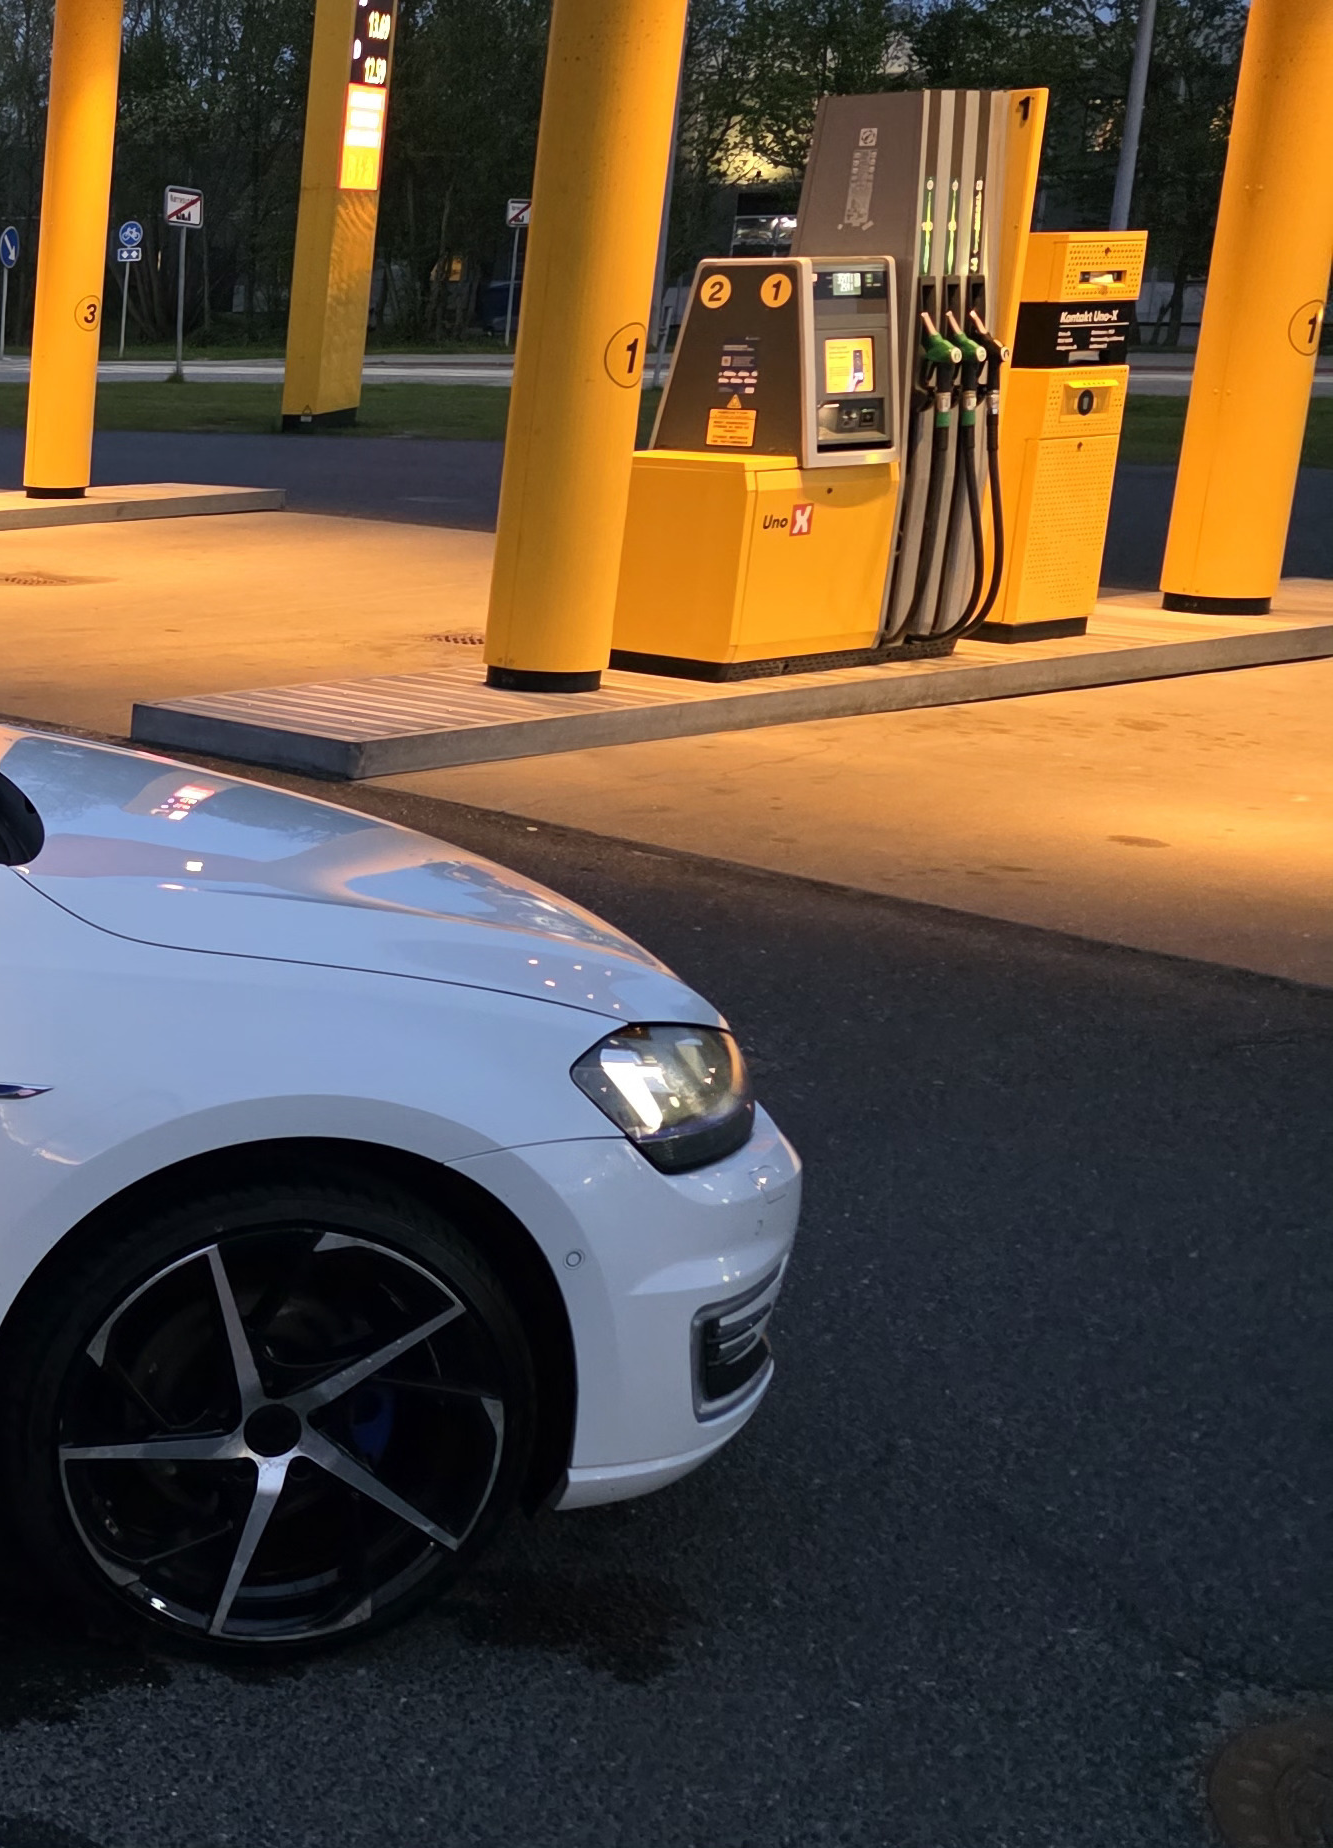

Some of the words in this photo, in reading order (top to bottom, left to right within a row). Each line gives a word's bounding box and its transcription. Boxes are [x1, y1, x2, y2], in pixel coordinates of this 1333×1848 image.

[1019, 96, 1032, 121] 1
[708, 281, 724, 302] 2
[771, 280, 783, 301] 1
[83, 303, 97, 324] 3
[1059, 310, 1093, 323] Kontakt
[1307, 311, 1317, 344] 1
[626, 338, 639, 374] 1
[762, 514, 789, 530] Uno
[792, 504, 813, 534] X
